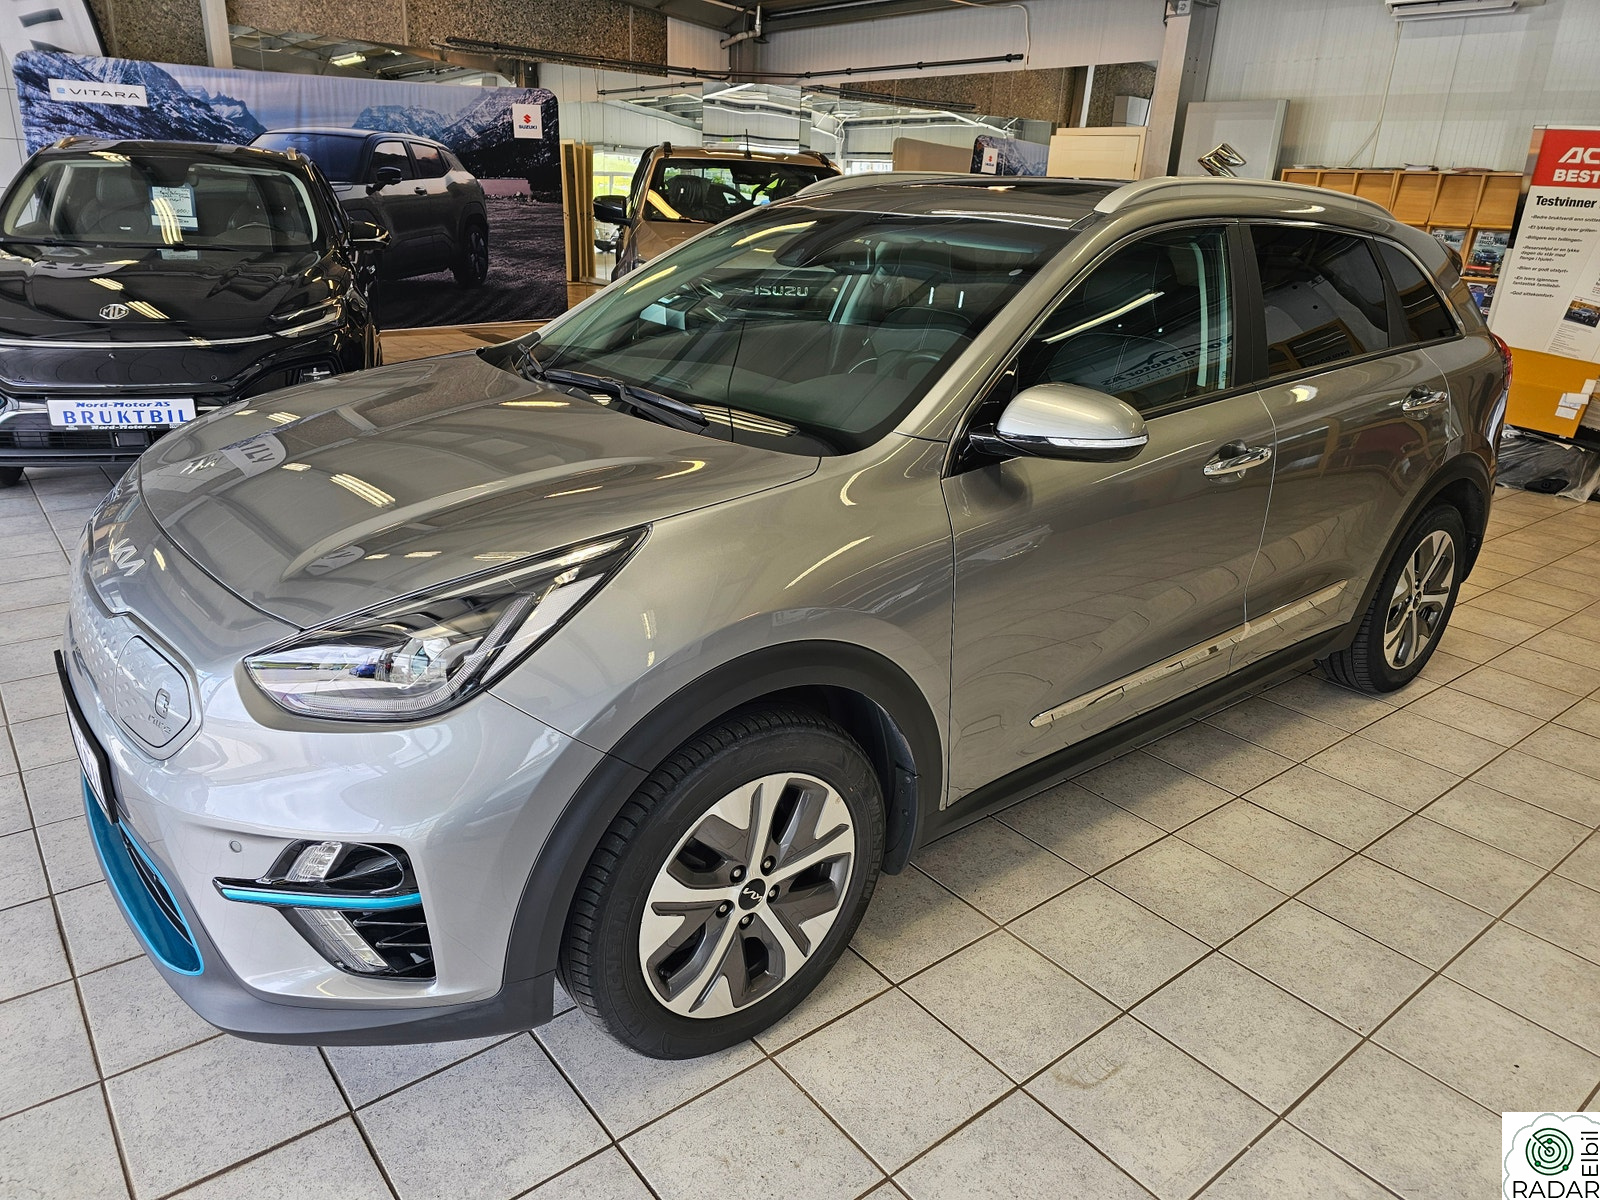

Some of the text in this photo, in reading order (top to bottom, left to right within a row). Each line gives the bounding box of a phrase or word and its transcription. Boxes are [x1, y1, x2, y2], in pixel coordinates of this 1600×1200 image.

[69, 88, 140, 99] VITARA
[1552, 168, 1600, 184] BEST
[1535, 195, 1597, 209] Testvinner
[754, 285, 809, 297] ISUZU
[99, 303, 130, 320] MG
[62, 409, 189, 424] BRUKTBIL
